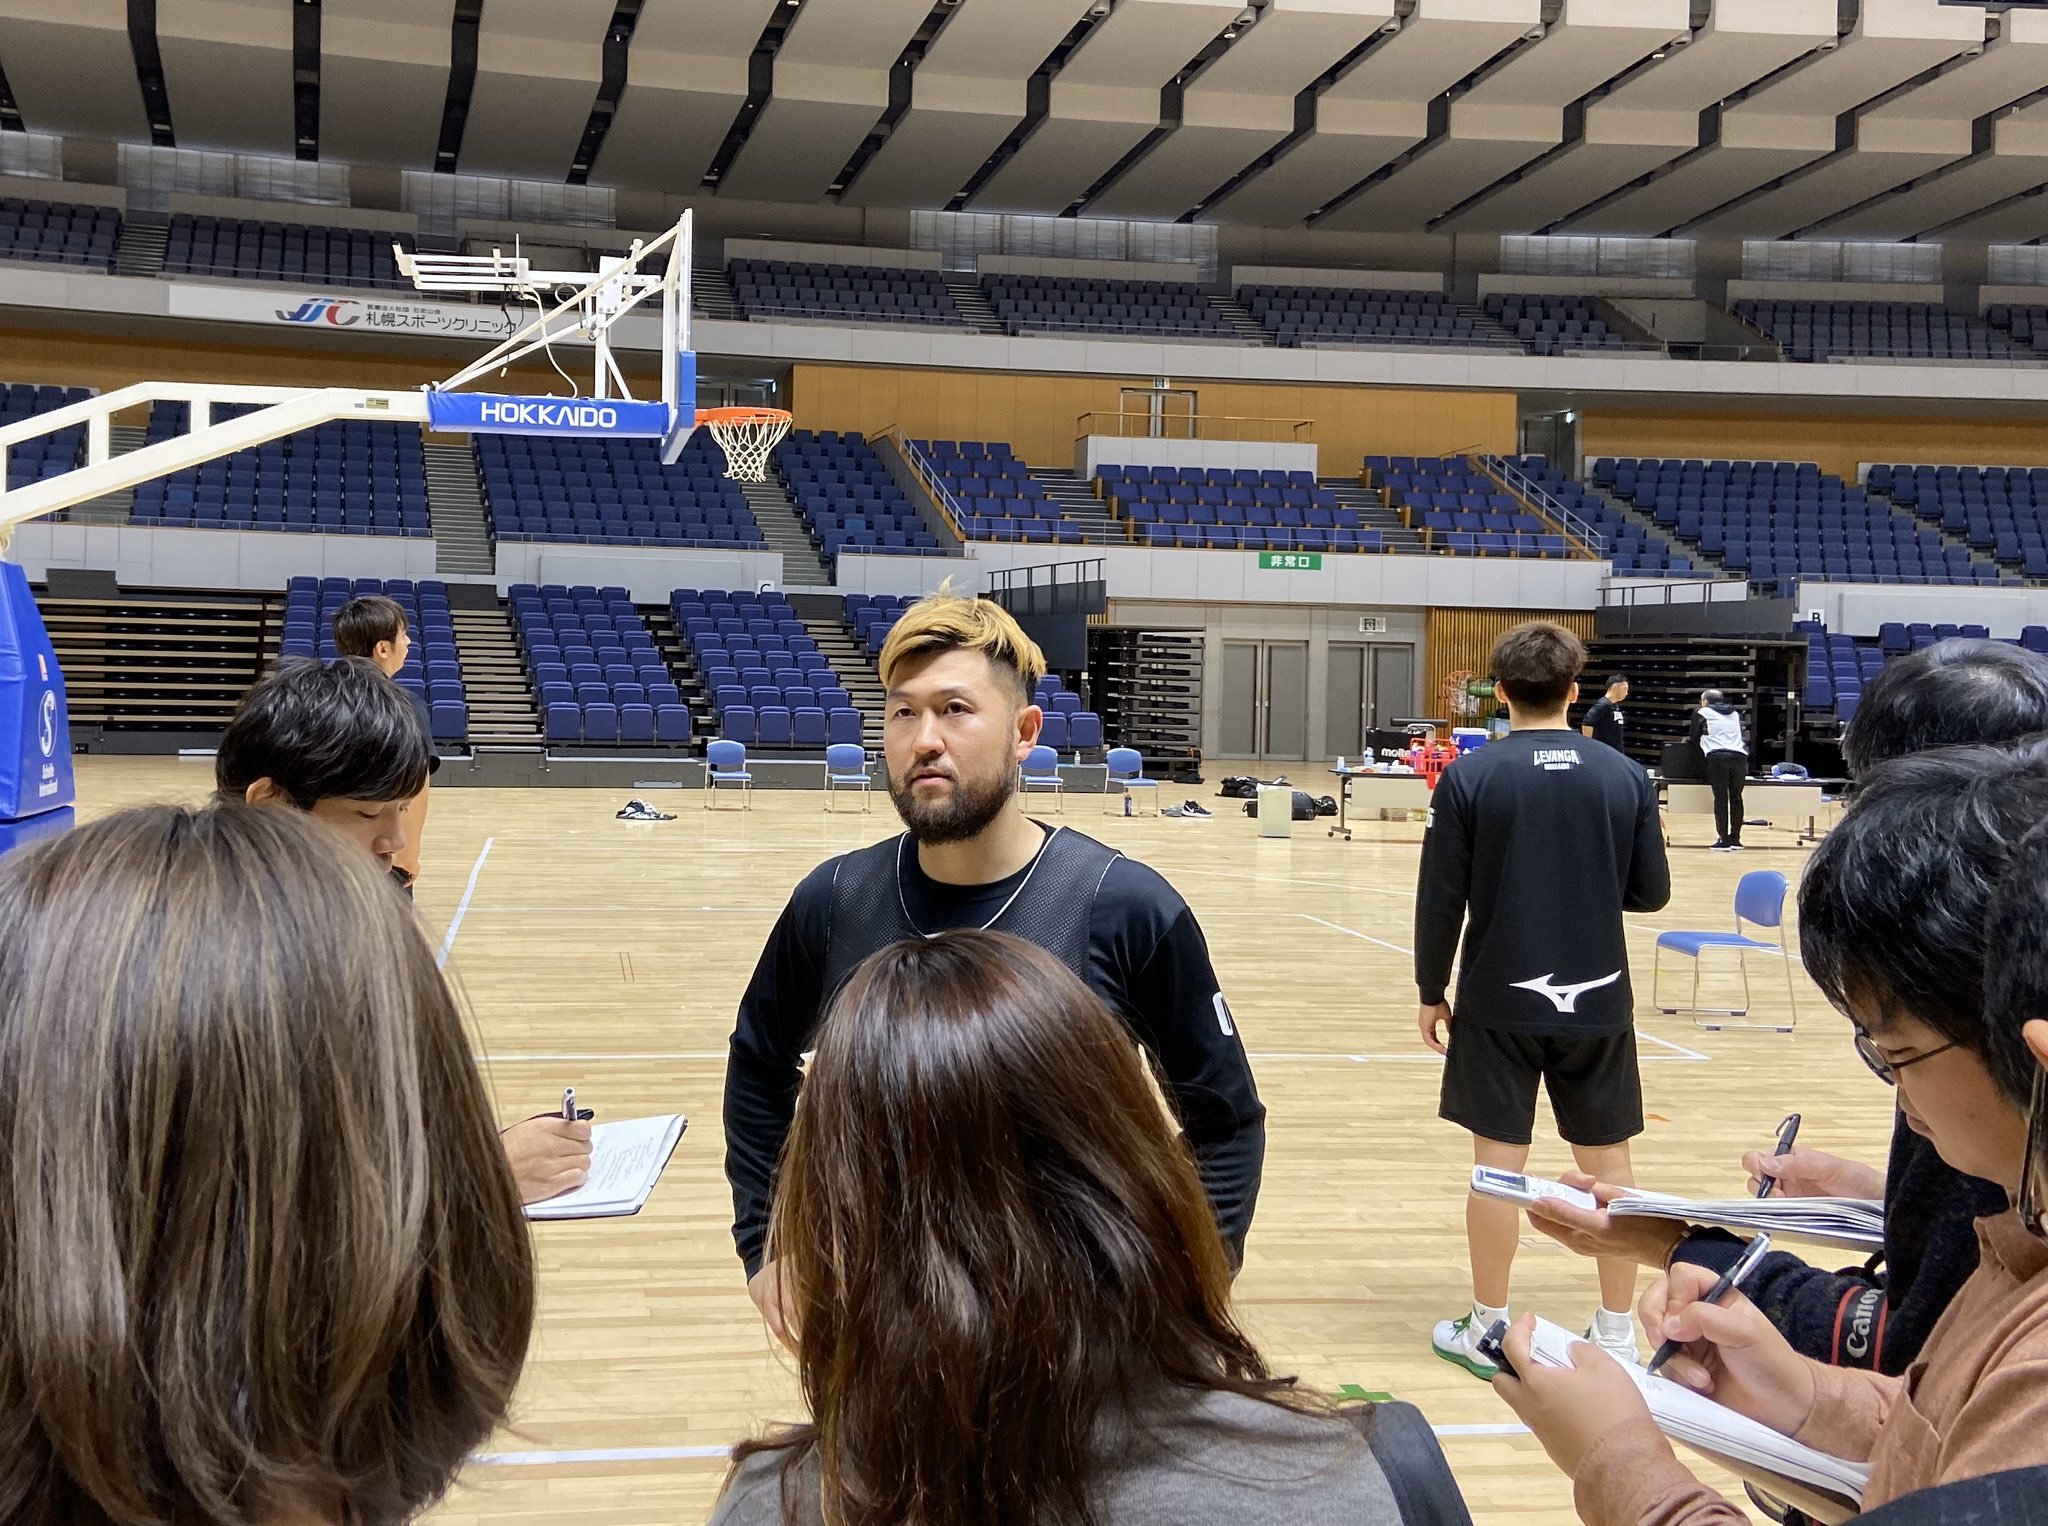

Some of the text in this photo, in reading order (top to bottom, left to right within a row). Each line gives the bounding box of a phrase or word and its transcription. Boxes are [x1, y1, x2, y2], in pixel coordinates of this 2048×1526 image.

[365, 311, 518, 334] 札幌スポーツクリニック
[480, 402, 617, 428] HOKKAIDO
[1270, 555, 1310, 567] 非常口
[1381, 748, 1411, 758] molte
[1533, 749, 1581, 766] LEVANGA
[1846, 1288, 1884, 1358] Canon
